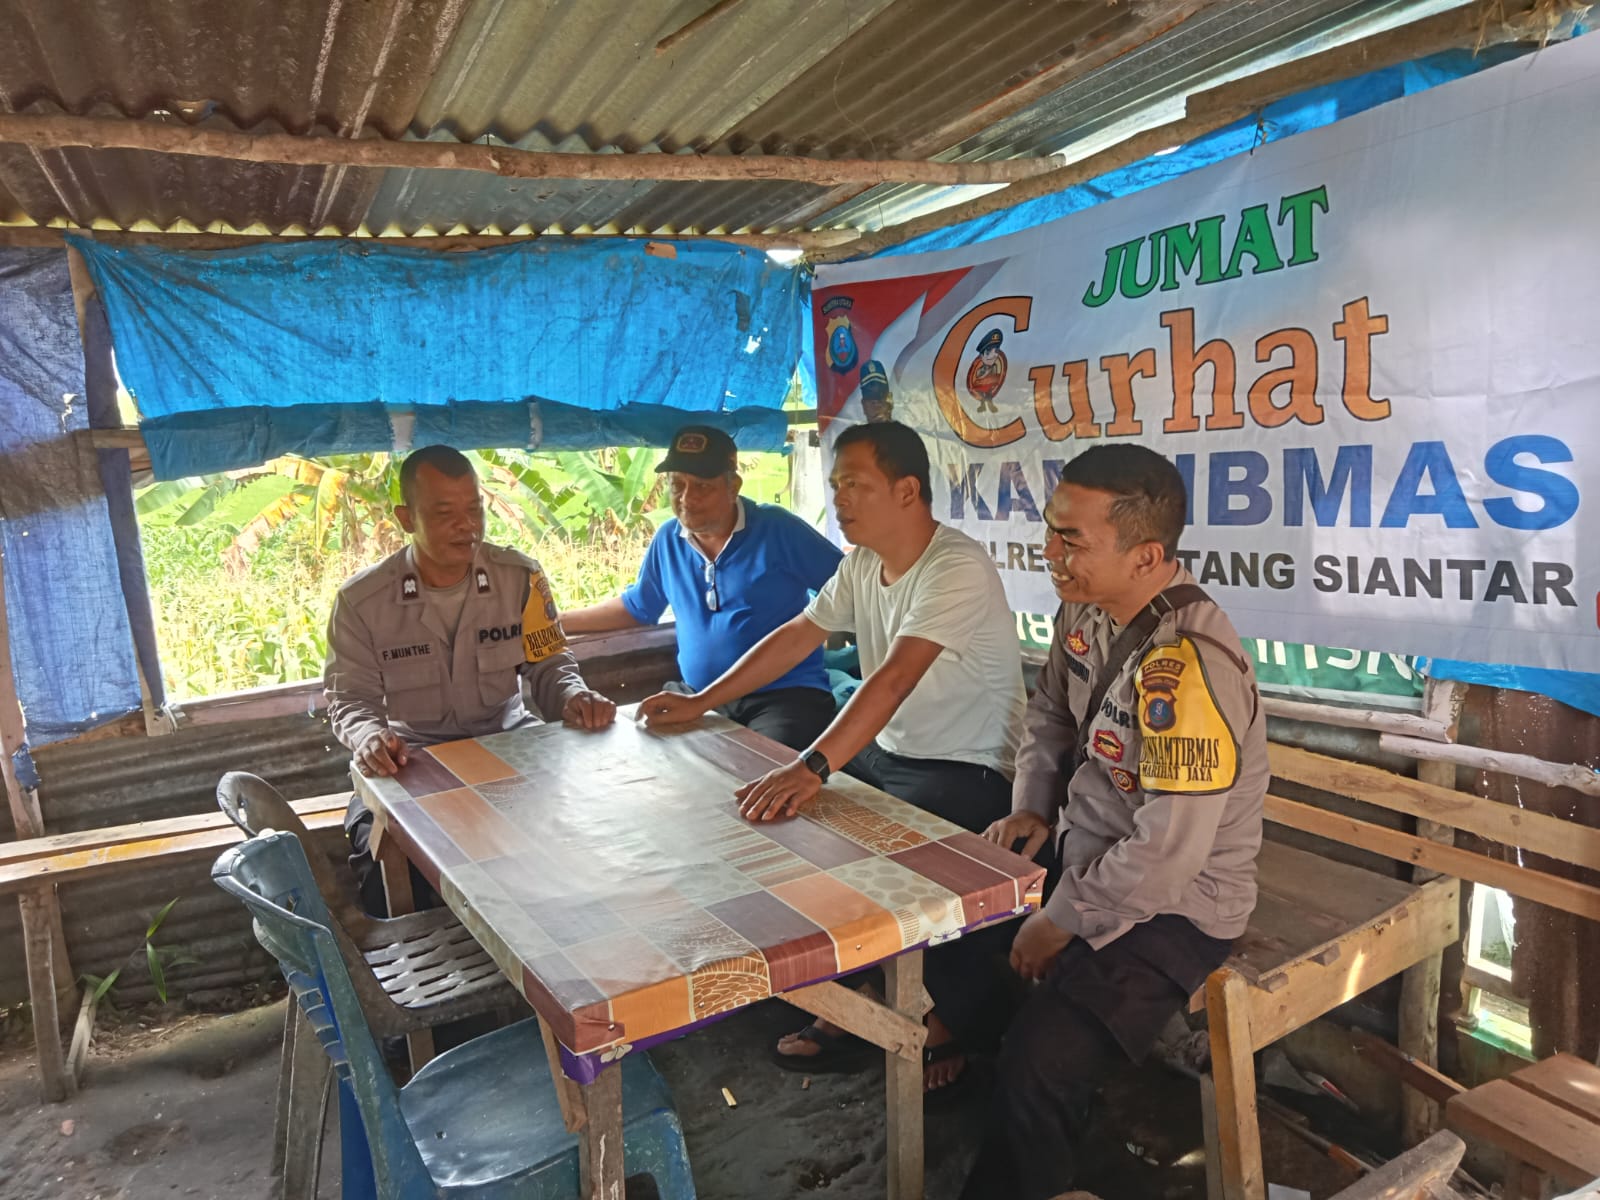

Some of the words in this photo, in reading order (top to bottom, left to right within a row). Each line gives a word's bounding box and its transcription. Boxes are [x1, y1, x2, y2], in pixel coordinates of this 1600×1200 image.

[1082, 185, 1329, 308] JUMAT
[932, 296, 1391, 448] Curhat
[1313, 554, 1578, 607] SIANTAR
[1186, 766, 1213, 783] JAYA
